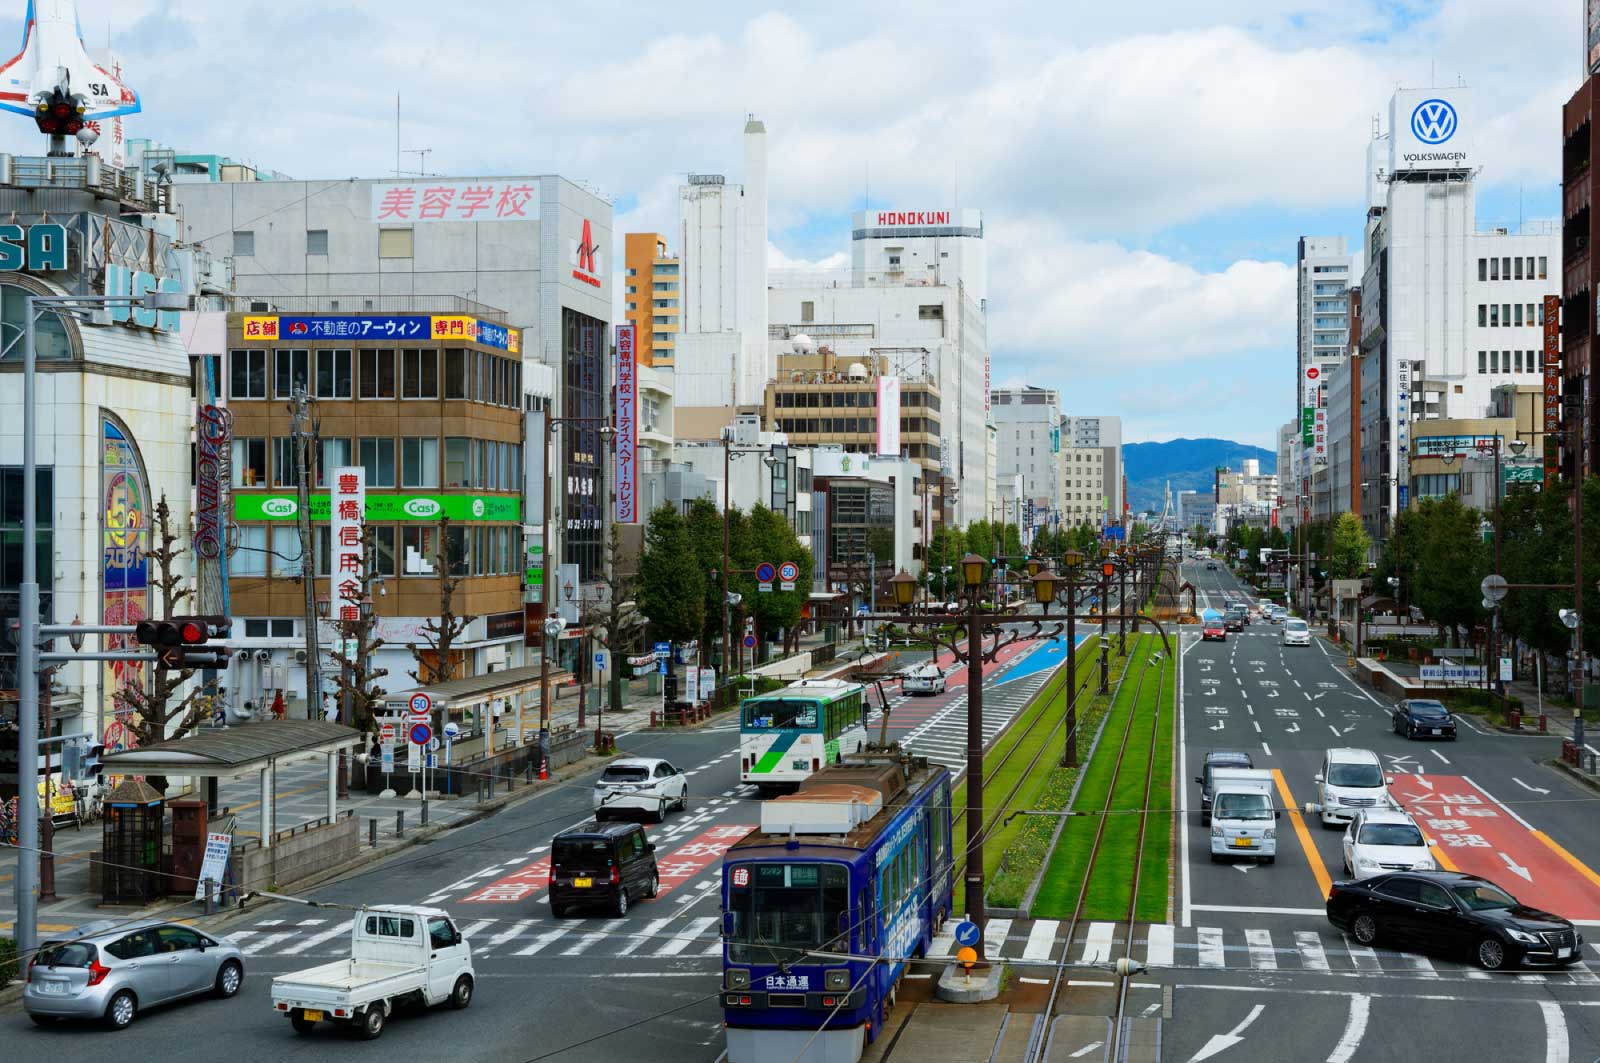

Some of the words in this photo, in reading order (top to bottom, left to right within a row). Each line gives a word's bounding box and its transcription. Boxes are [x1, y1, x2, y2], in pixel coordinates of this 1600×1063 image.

[88, 83, 109, 96] SA
[1403, 152, 1466, 161] VOLKSWAGEN
[377, 184, 535, 220] 美容学校
[878, 212, 950, 225] HONOKUNI
[245, 320, 277, 336] 店舗
[312, 320, 420, 336] 不動産のアーウィン
[434, 319, 464, 336] 専門
[1546, 296, 1557, 364] インターネット
[619, 329, 631, 394] 美容専門学校
[266, 502, 292, 514] Cast
[409, 502, 434, 514] Cast
[338, 473, 360, 622] 豊橋信用金庫
[783, 568, 794, 577] 50
[414, 699, 427, 709] 50
[766, 975, 809, 987] 日本通運
